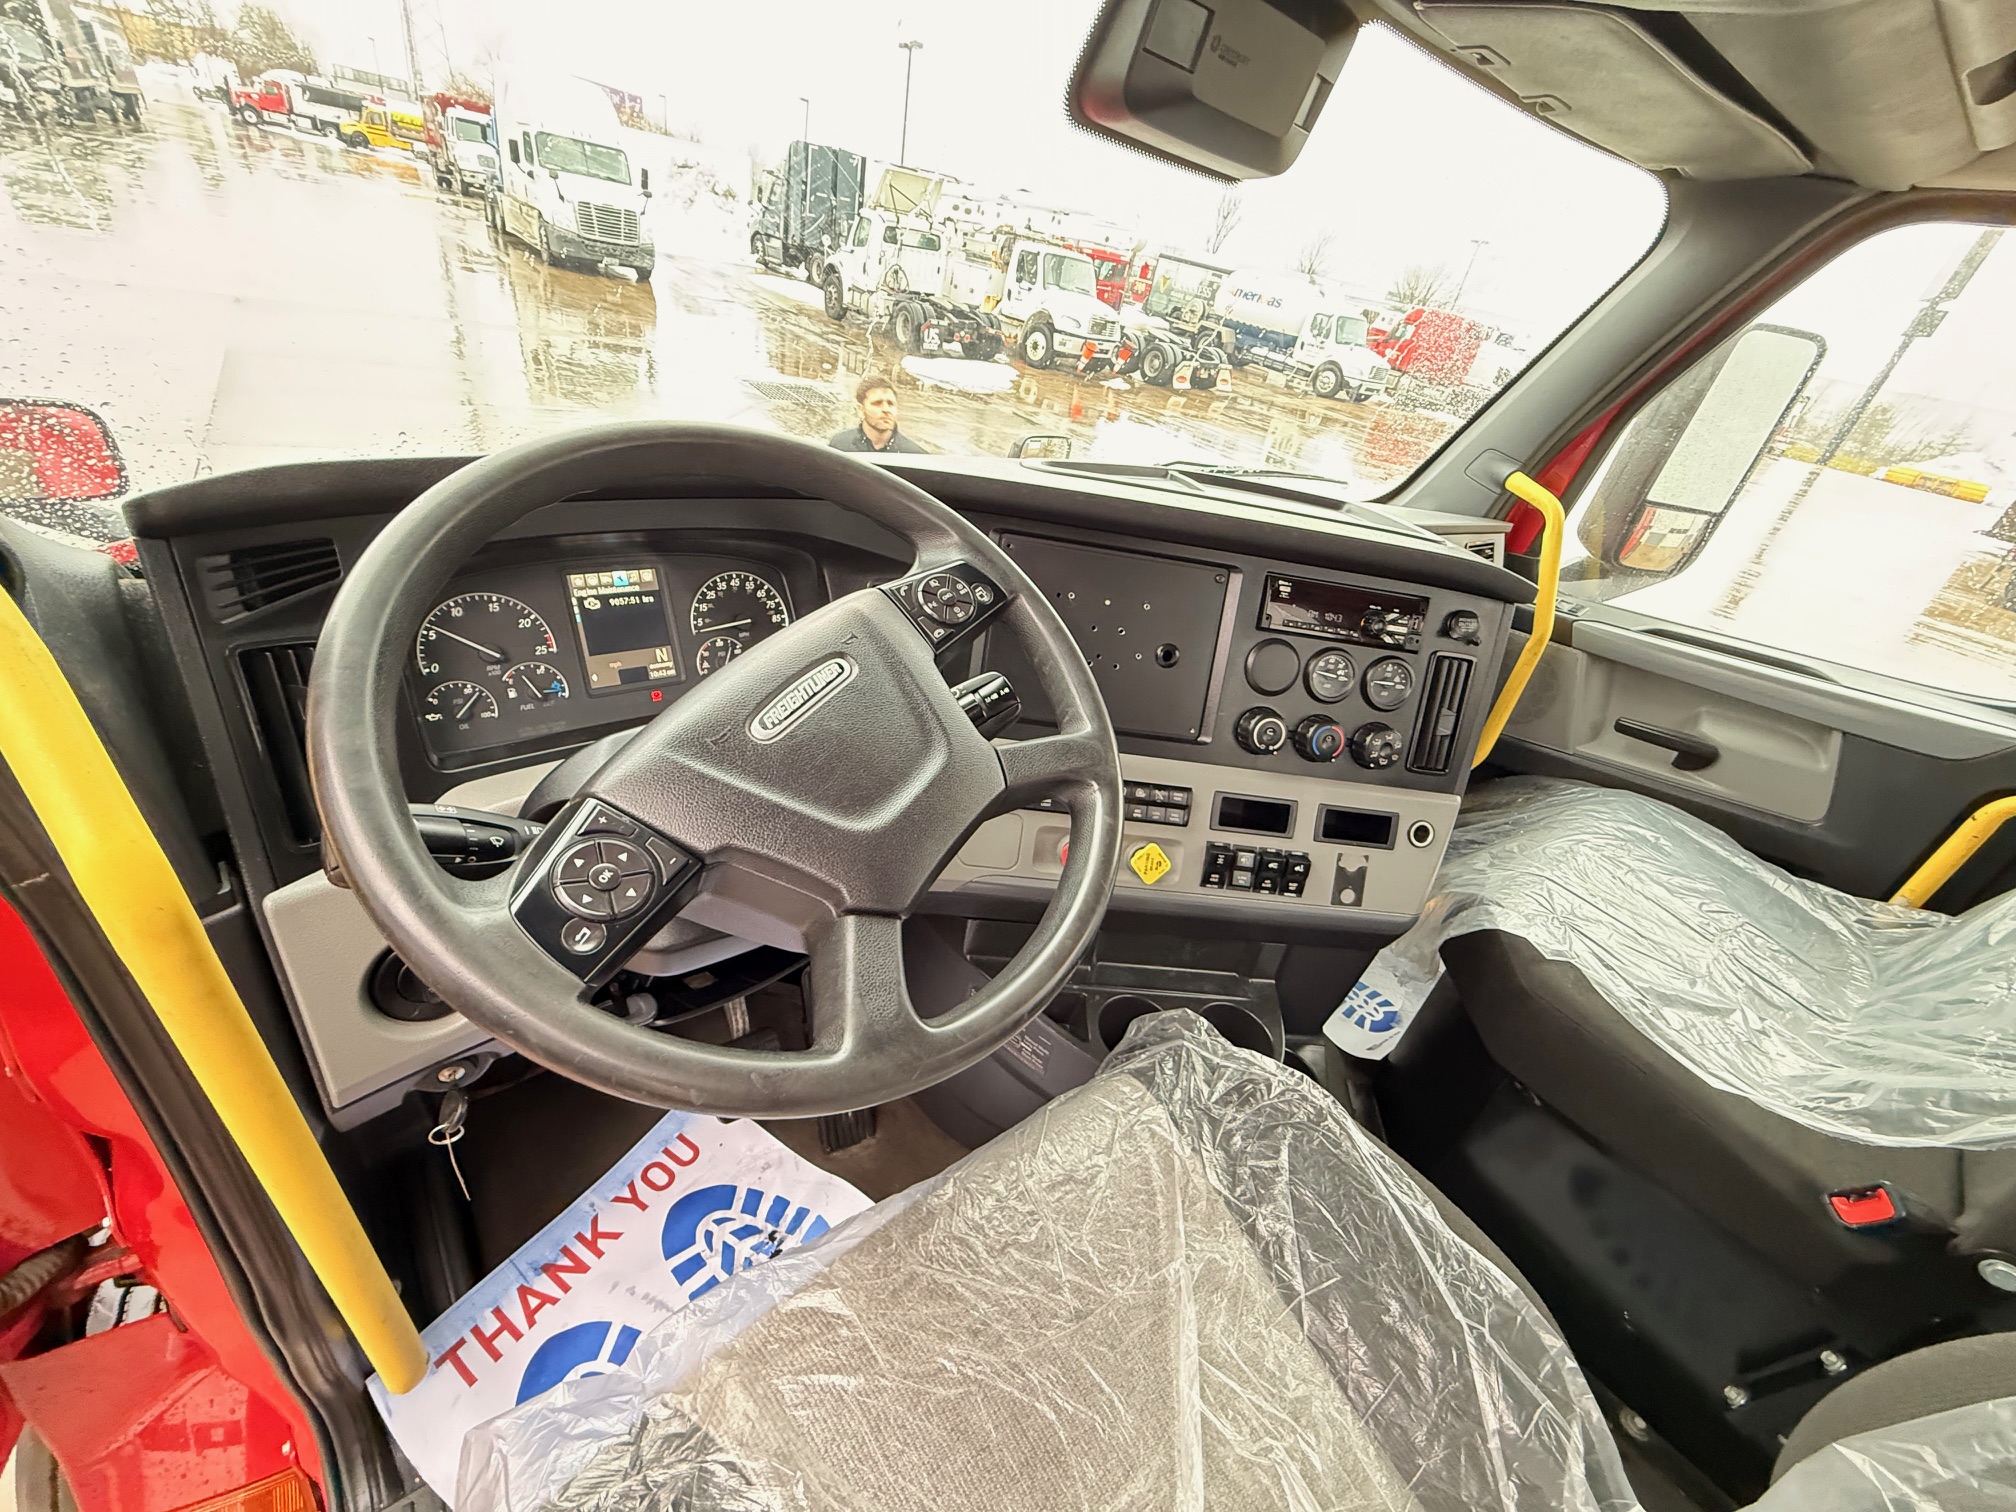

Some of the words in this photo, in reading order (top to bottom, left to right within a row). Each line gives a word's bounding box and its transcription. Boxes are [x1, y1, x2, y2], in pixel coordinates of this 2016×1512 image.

[716, 581, 727, 590] 35
[730, 578, 740, 587] 45
[745, 581, 755, 590] 55
[706, 590, 716, 599] 25
[756, 589, 766, 598] 65
[488, 603, 500, 613] 15
[699, 603, 708, 612] 15
[766, 600, 776, 609] 75
[450, 607, 463, 617] 10
[518, 618, 532, 628] 20
[697, 618, 703, 626] 5
[771, 614, 781, 623] 85
[428, 630, 437, 640] 5
[535, 645, 548, 655] 25
[655, 647, 669, 662] N
[430, 663, 439, 673] 0
[762, 662, 843, 730] FREIGHTLINER
[598, 868, 614, 883] OK
[433, 1214, 624, 1388] THANK
[610, 1132, 701, 1213] YOU
